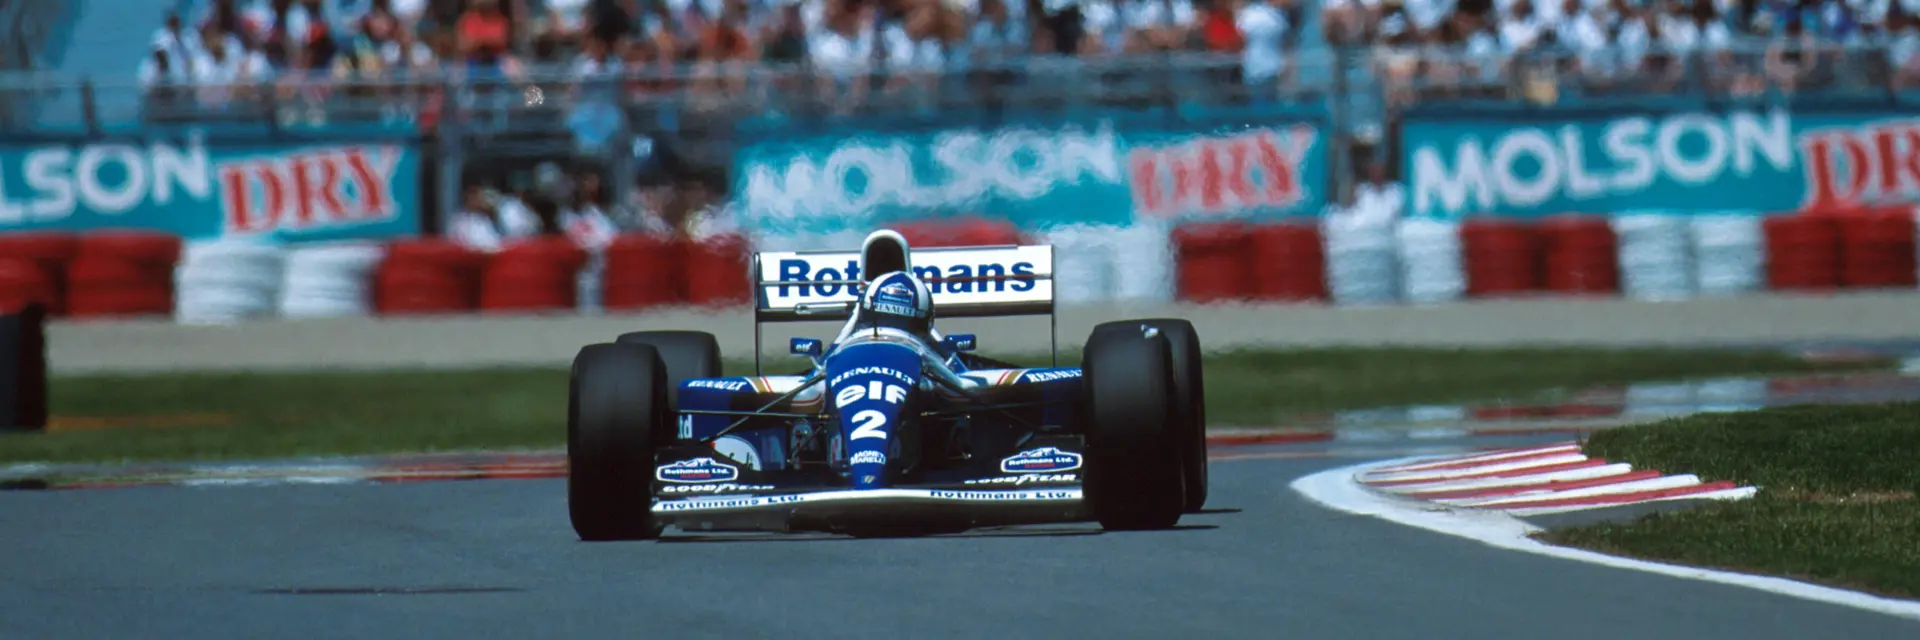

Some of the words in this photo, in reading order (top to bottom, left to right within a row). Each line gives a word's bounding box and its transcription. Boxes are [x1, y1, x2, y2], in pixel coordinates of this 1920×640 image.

[743, 122, 1124, 208] MOLSON
[1131, 124, 1314, 213] DRY
[1413, 106, 1792, 212] MOLSON
[221, 142, 401, 233] DRY
[779, 259, 1036, 297] Rotmans
[687, 380, 747, 391] RENAULT
[830, 366, 915, 387] RENAULT
[835, 381, 907, 408] elf
[850, 410, 887, 440] 2
[1008, 457, 1054, 466] Rothmans
[663, 484, 775, 493] GOODYEAR
[964, 474, 1076, 486] GOODYEAR
